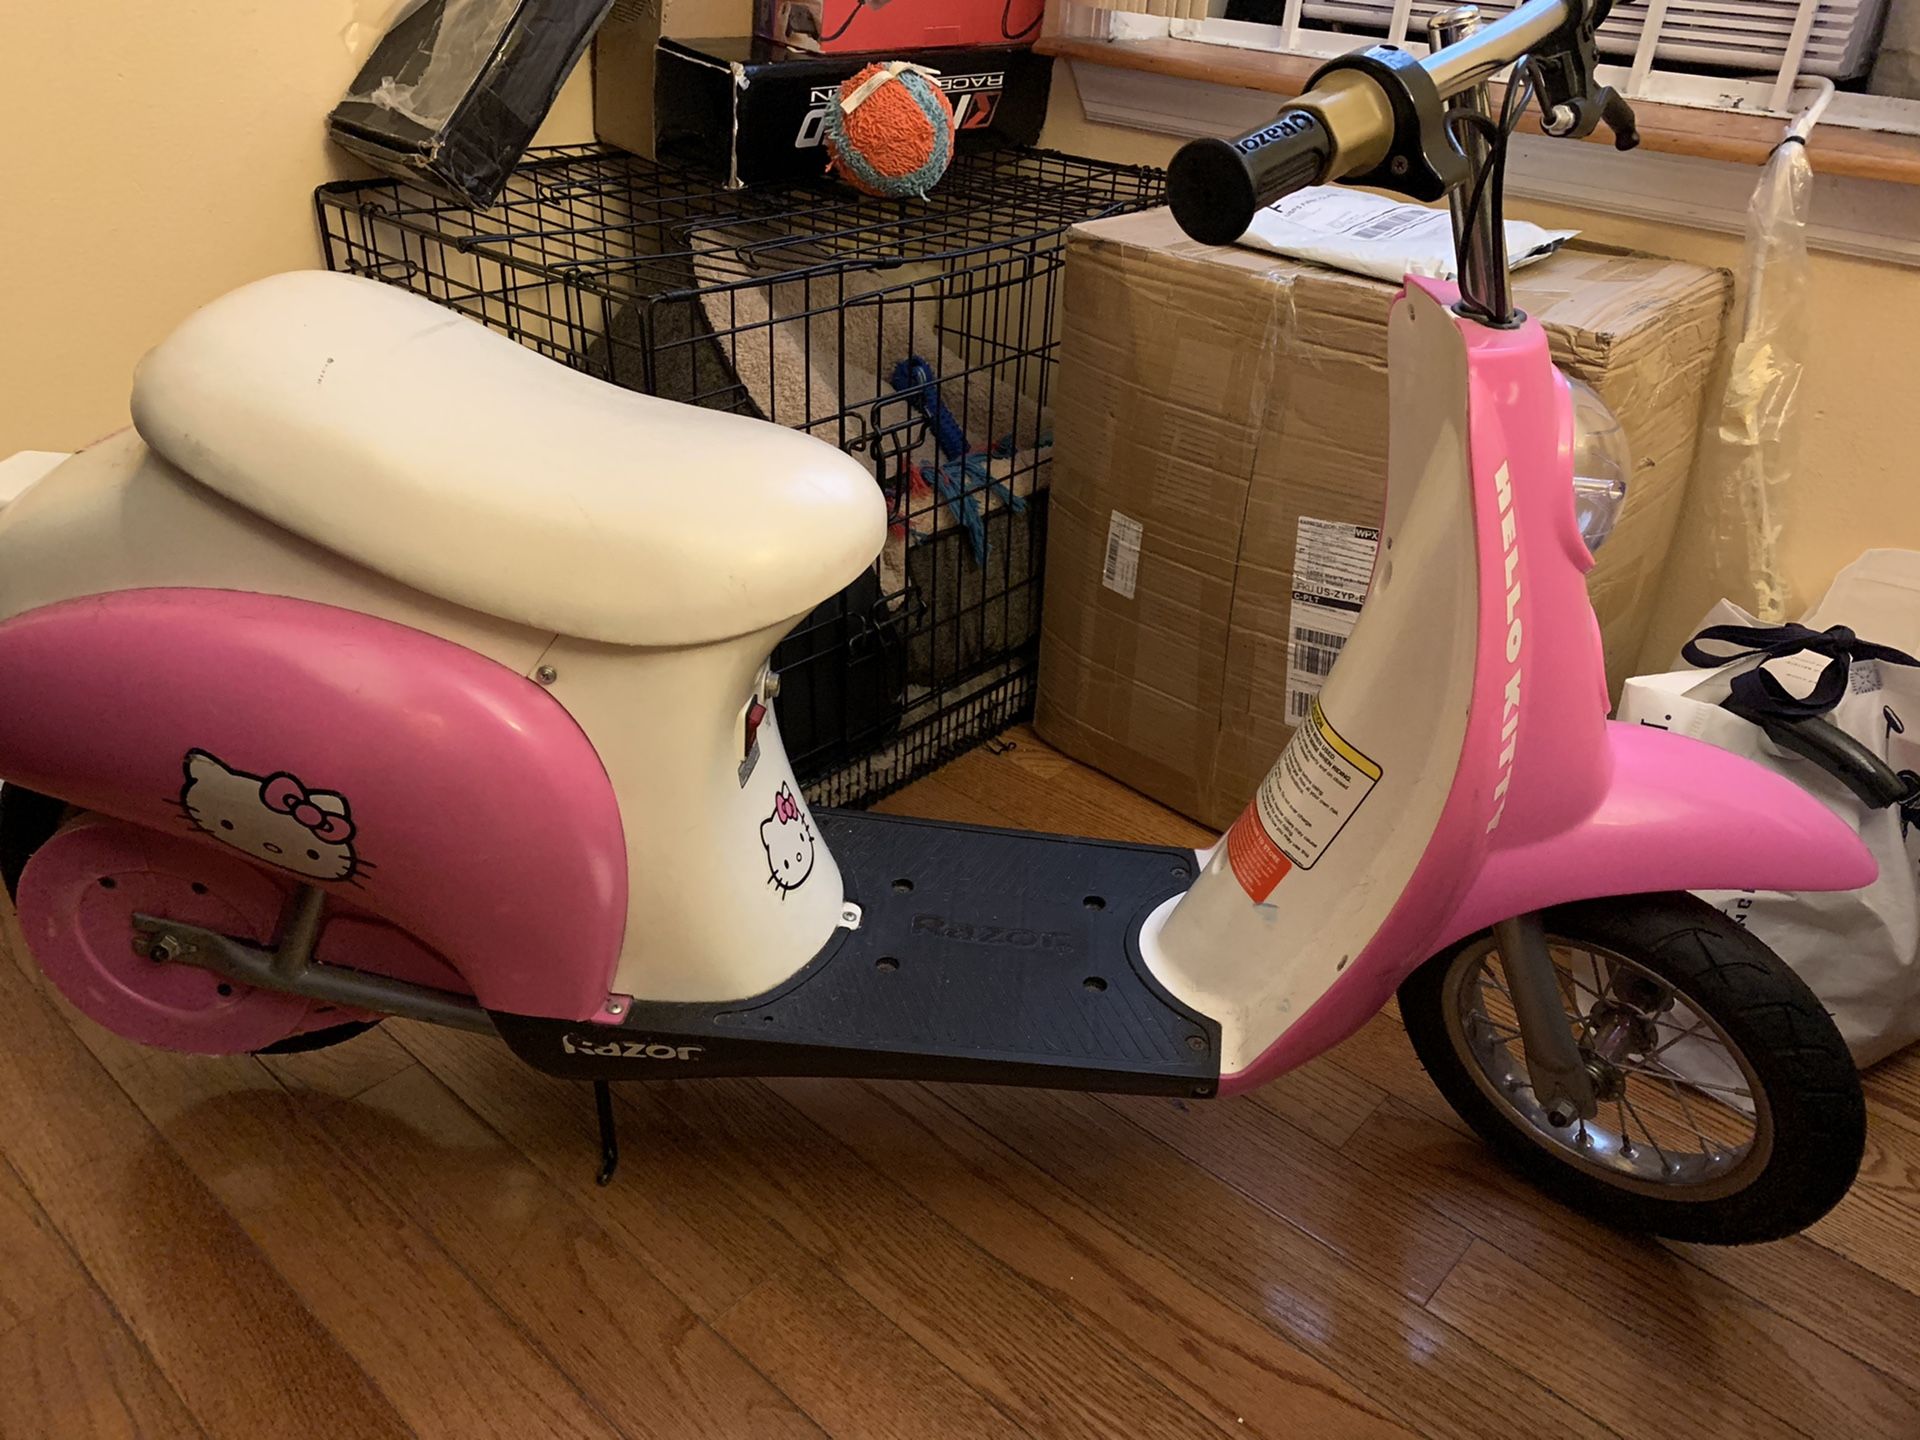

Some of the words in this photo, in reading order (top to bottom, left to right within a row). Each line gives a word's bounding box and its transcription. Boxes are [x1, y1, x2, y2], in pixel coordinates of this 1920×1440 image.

[1355, 528, 1378, 540] WPX
[1494, 460, 1522, 662] HELLO
[1486, 668, 1521, 834] KITTY
[911, 912, 1072, 951] Razor
